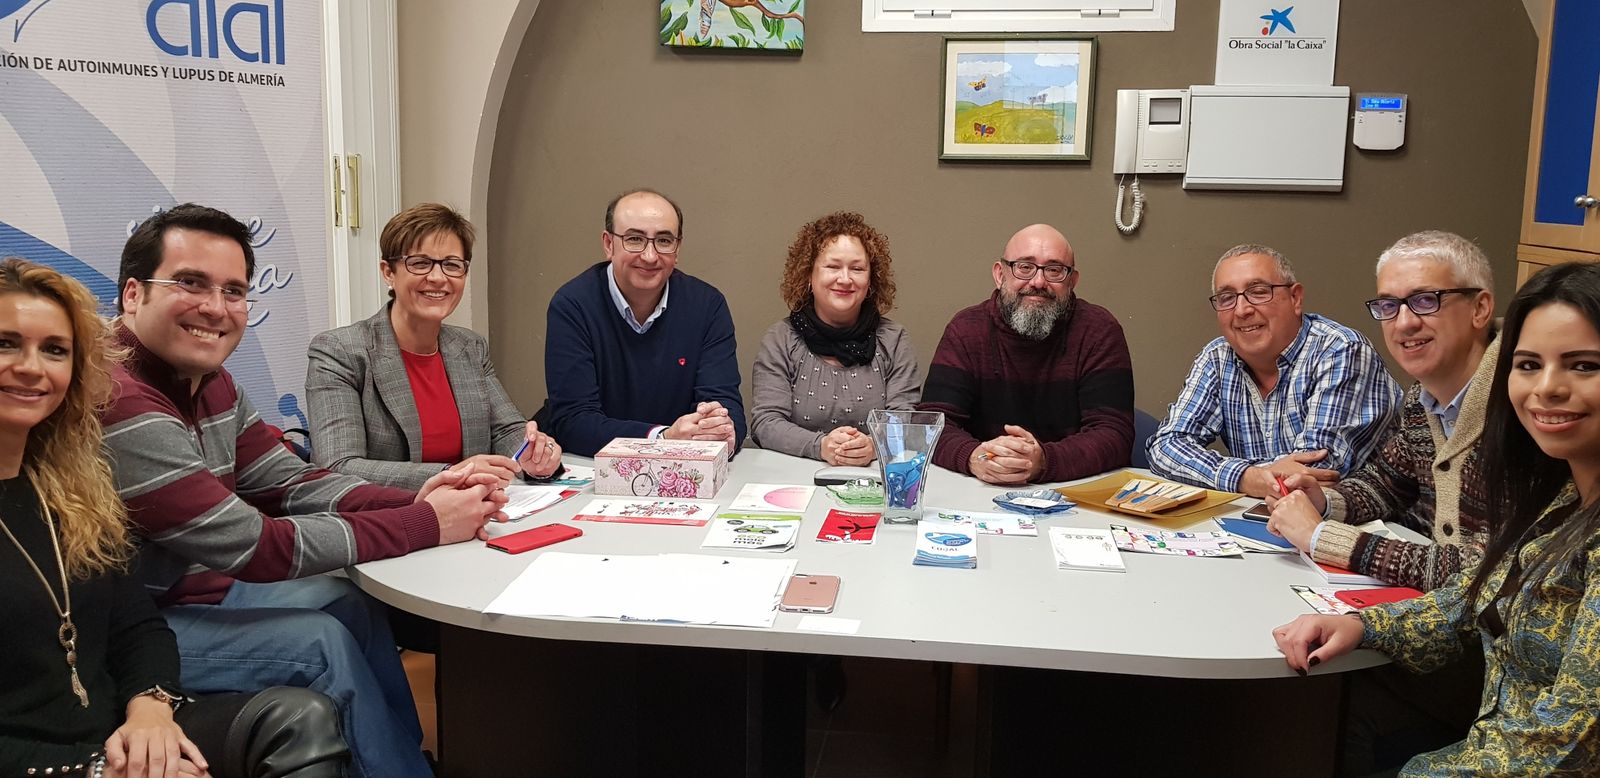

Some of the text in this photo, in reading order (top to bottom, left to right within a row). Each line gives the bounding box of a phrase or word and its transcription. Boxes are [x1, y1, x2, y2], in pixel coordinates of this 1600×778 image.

[1228, 39, 1327, 50] Obra Social "la Caixa"
[0, 53, 286, 87] IÓN DE AUTOINMUNES Y LUPUS DE ALMERÍA
